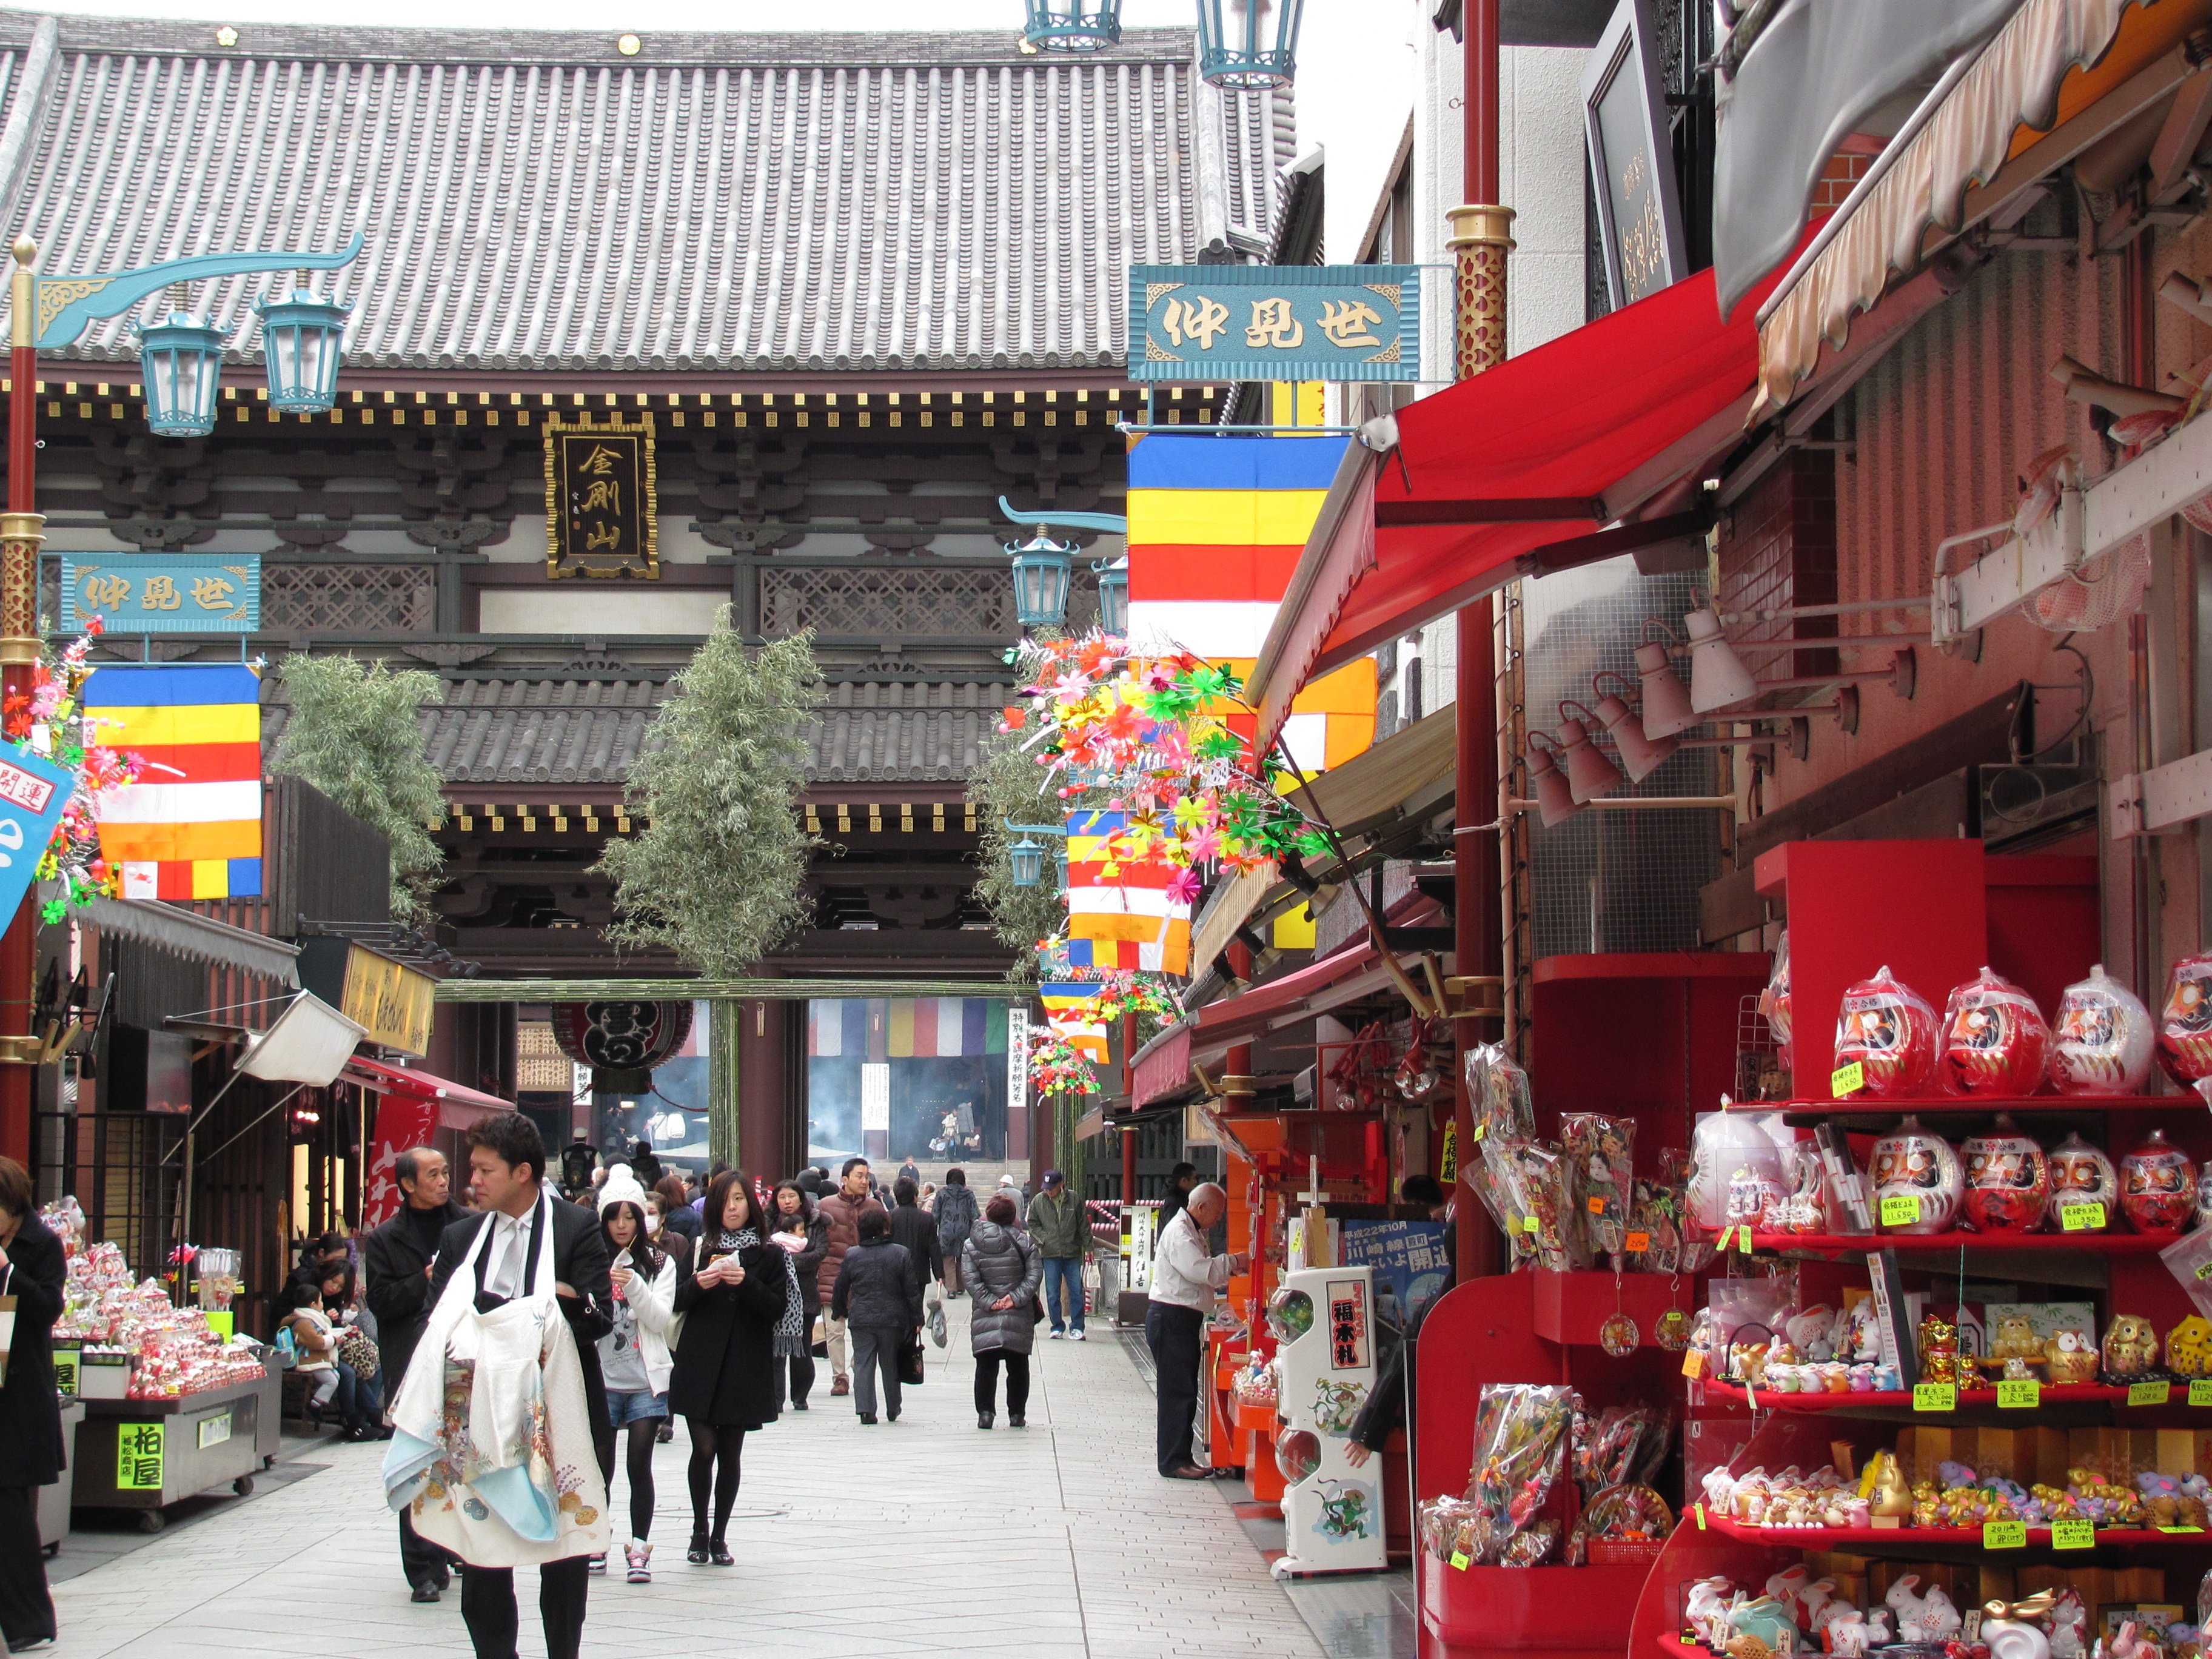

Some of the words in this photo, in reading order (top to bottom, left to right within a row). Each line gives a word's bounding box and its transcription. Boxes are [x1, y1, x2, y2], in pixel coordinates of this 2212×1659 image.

[1163, 295, 1382, 350] 仲見世
[578, 444, 623, 551] 金剛山
[85, 575, 235, 611] 仲見世
[0, 769, 45, 809] 開運
[1344, 1221, 1407, 1239] 平成22年10月
[133, 1426, 161, 1486] 柏屋
